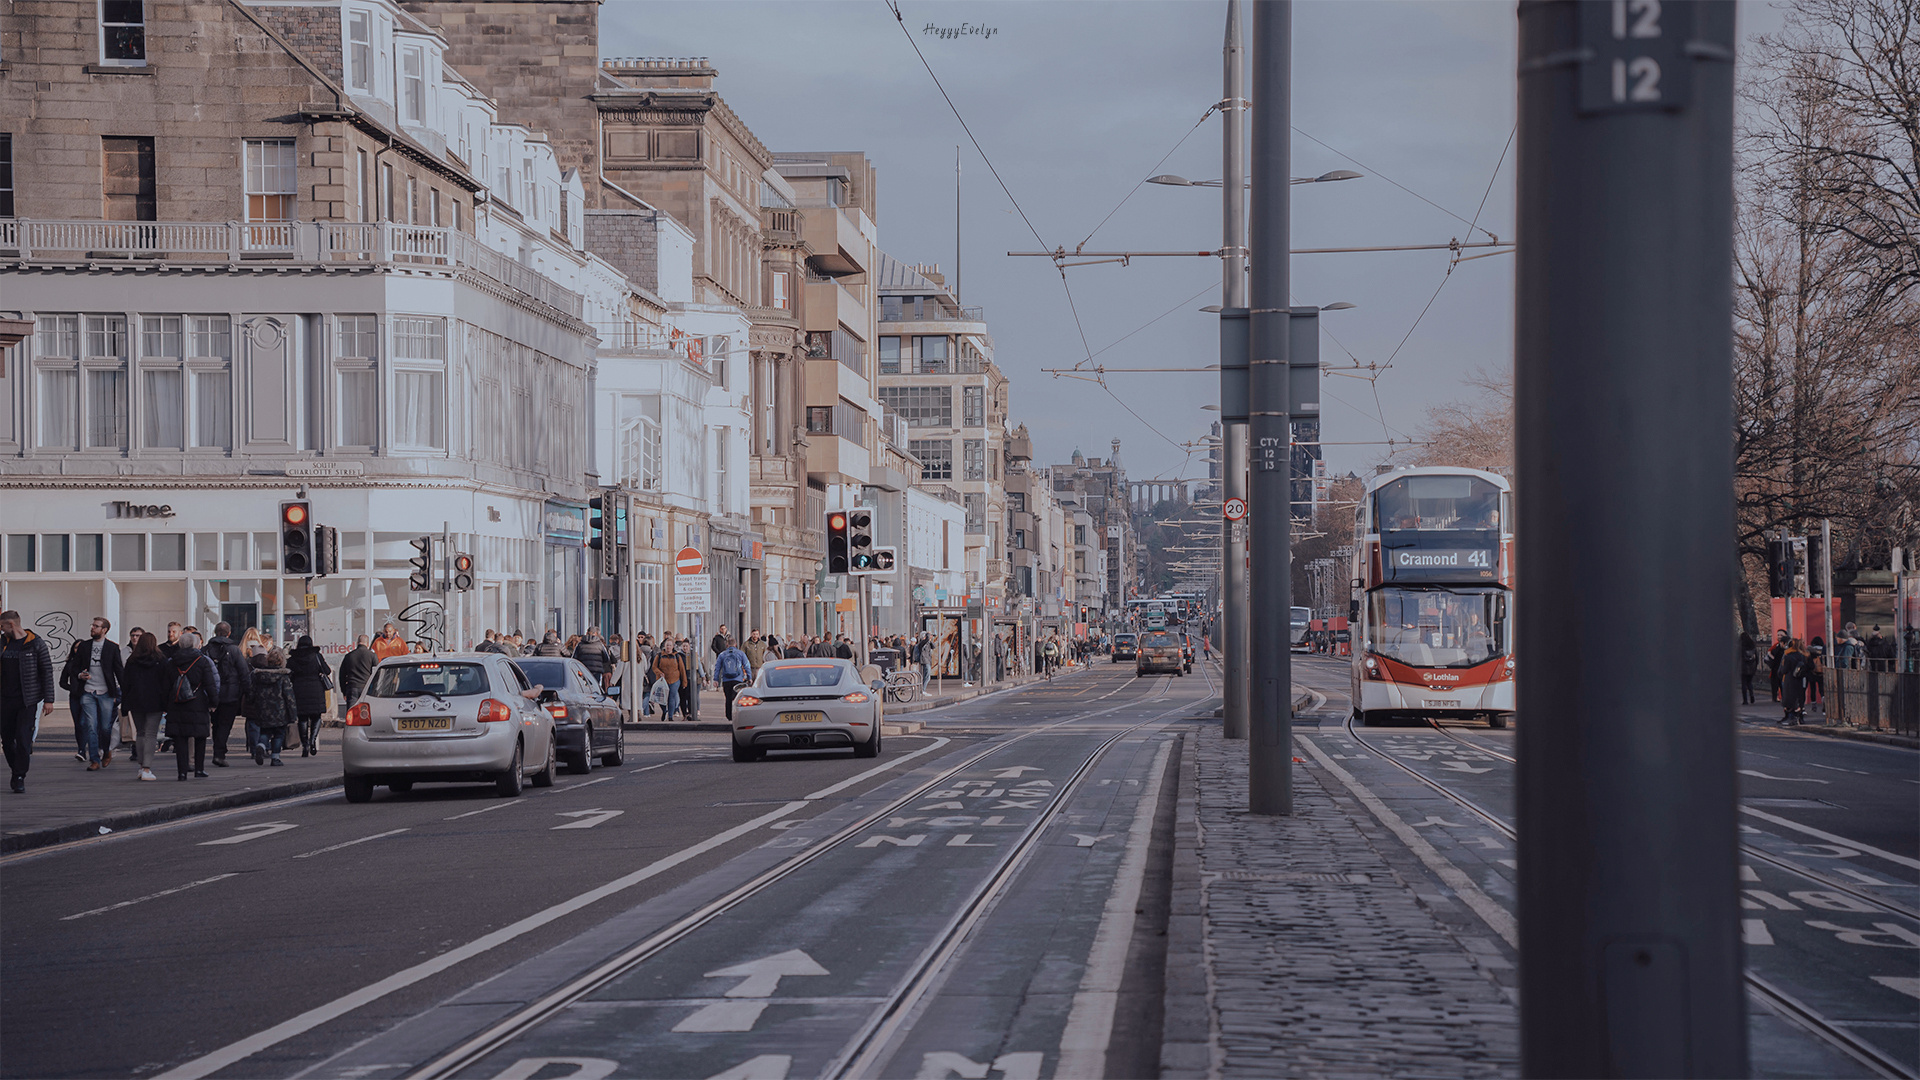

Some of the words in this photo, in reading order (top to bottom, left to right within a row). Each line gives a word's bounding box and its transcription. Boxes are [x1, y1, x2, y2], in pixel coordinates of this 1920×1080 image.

[1611, 57, 1662, 102] 12
[1260, 437, 1280, 447] CTY
[1265, 449, 1275, 458] 12
[1265, 461, 1275, 470] 13
[1227, 504, 1243, 514] 20
[1400, 552, 1458, 565] Cramond
[1468, 550, 1489, 567] 41
[1433, 673, 1459, 681] Lothian
[784, 713, 801, 722] SA18
[803, 713, 818, 721] VUY
[401, 719, 426, 729] ST07
[428, 719, 447, 728] NZO
[924, 788, 1050, 799] BUS
